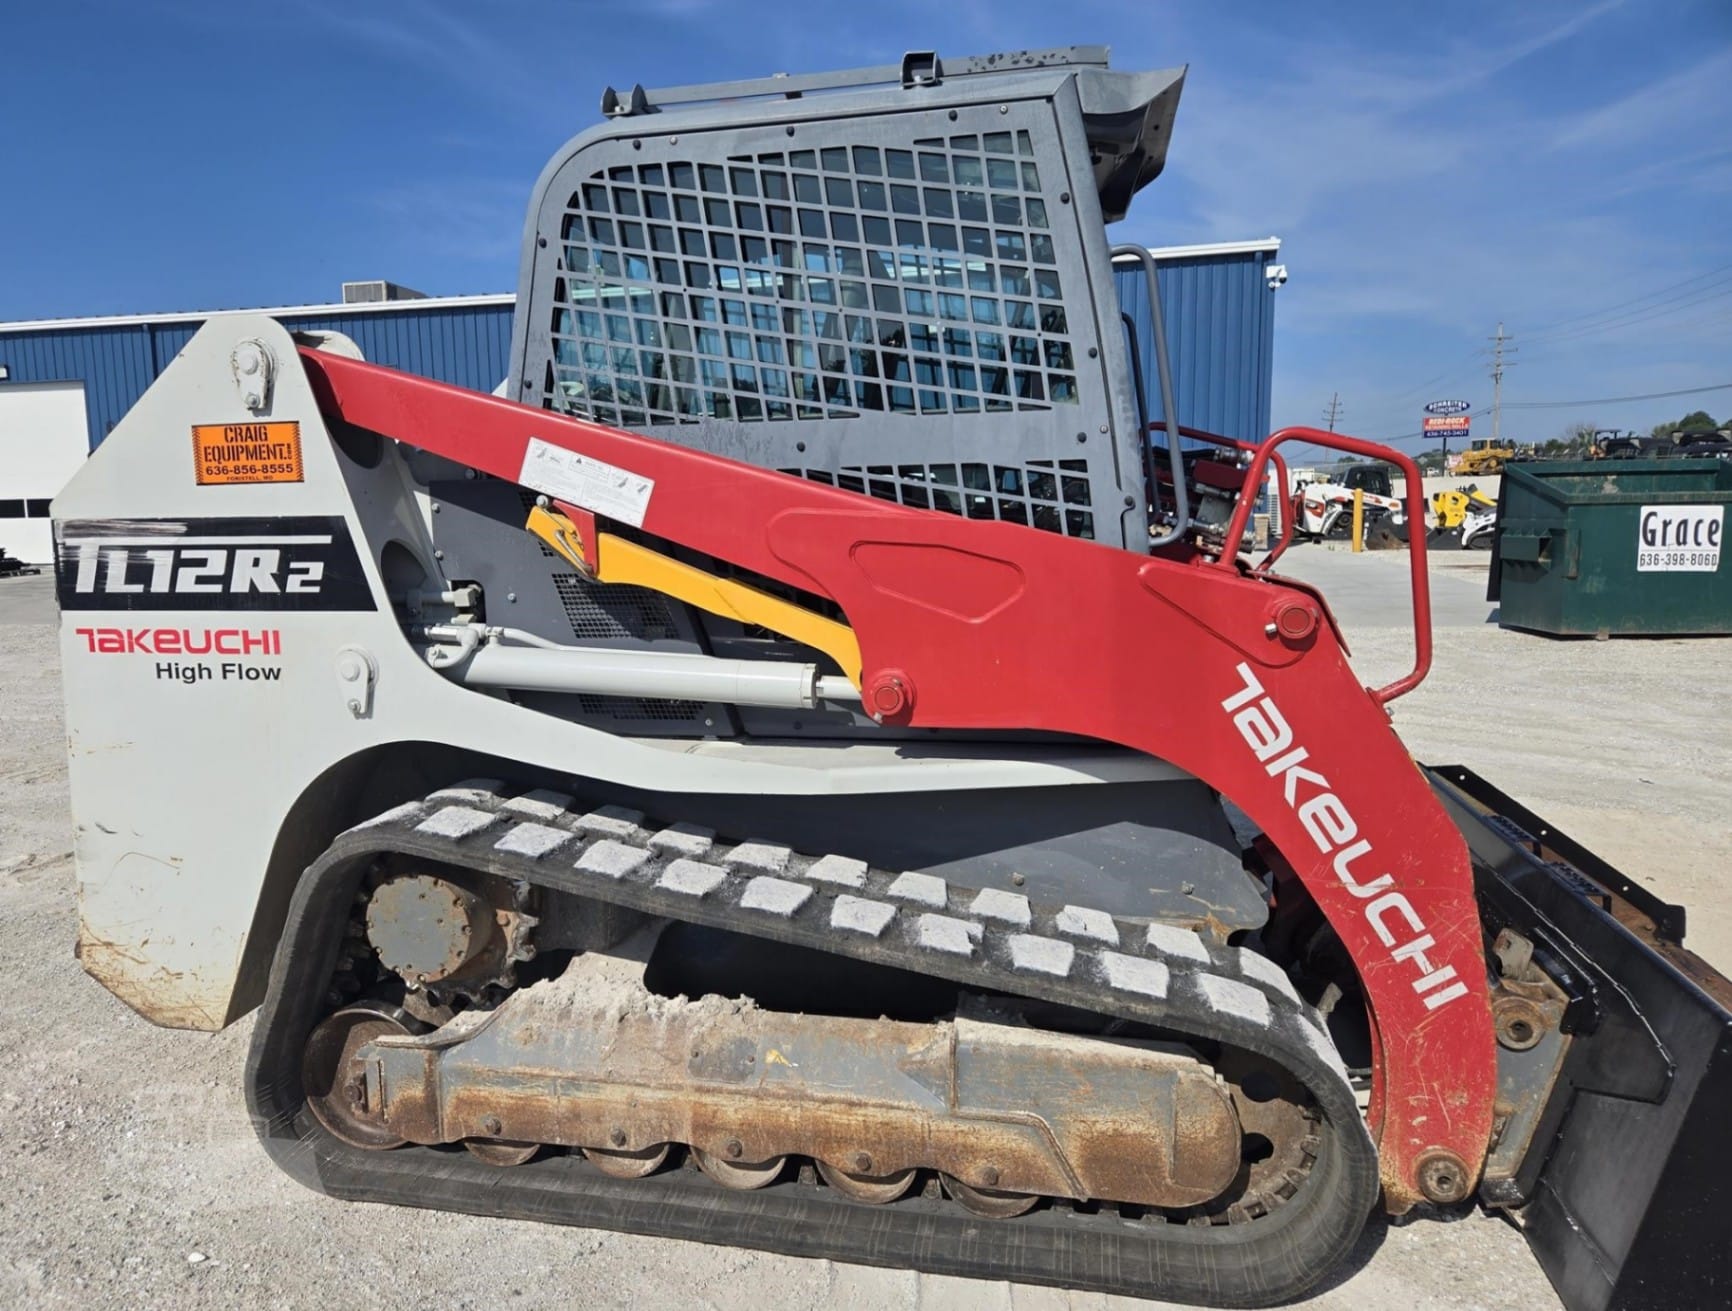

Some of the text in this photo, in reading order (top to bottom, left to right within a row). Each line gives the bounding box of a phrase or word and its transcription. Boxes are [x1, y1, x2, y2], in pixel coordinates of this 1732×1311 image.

[224, 425, 268, 443] CRAIG
[206, 464, 293, 475] 636-856-8555
[1642, 511, 1720, 547] Grace
[1640, 553, 1717, 567] 636-398-8060
[156, 662, 281, 684] High Flow
